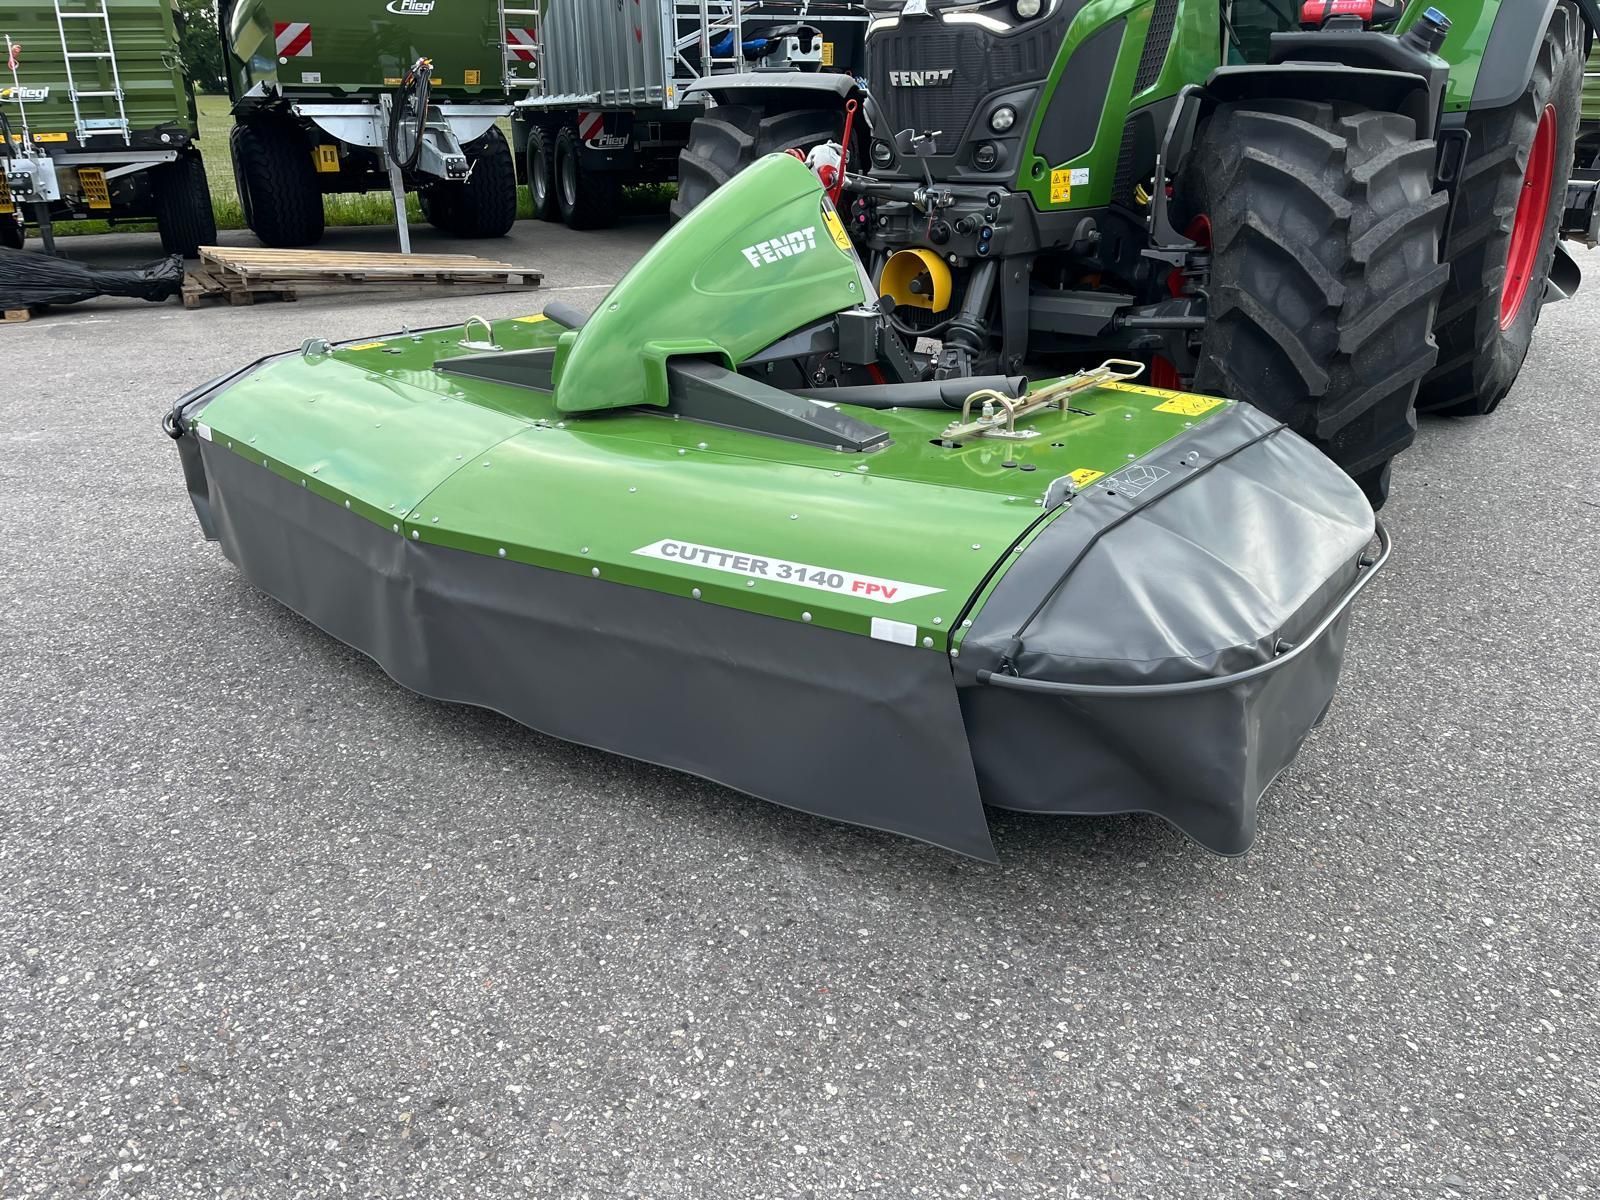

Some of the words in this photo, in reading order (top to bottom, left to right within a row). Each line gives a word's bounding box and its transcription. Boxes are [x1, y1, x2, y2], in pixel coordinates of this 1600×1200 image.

[400, 0, 435, 13] Fliegl
[889, 69, 953, 87] FENDT
[598, 133, 630, 147] Fliegl
[741, 226, 817, 268] FENDT
[660, 542, 769, 575] CUTTER
[775, 564, 844, 588] 3140
[851, 580, 898, 599] FPV
